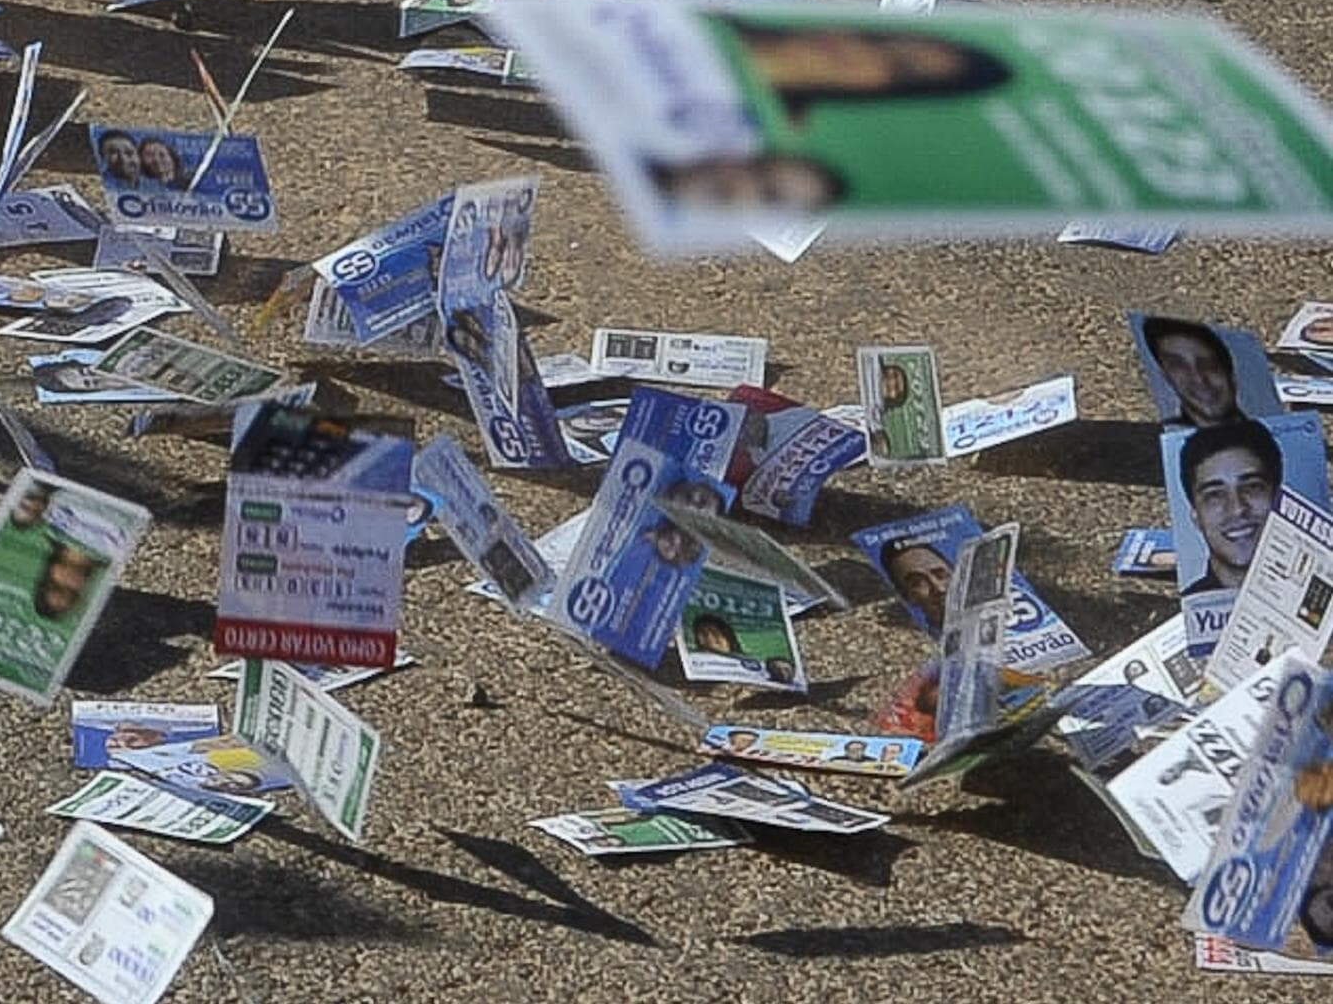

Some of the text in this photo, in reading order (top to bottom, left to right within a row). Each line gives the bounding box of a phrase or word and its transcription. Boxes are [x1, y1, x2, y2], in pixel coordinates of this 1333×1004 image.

[334, 250, 374, 280] 55
[494, 416, 527, 460] 55
[694, 409, 720, 437] 55
[566, 573, 617, 627] 55
[223, 627, 385, 660] COMO VOTAR CERTO
[1203, 857, 1260, 931] 55
